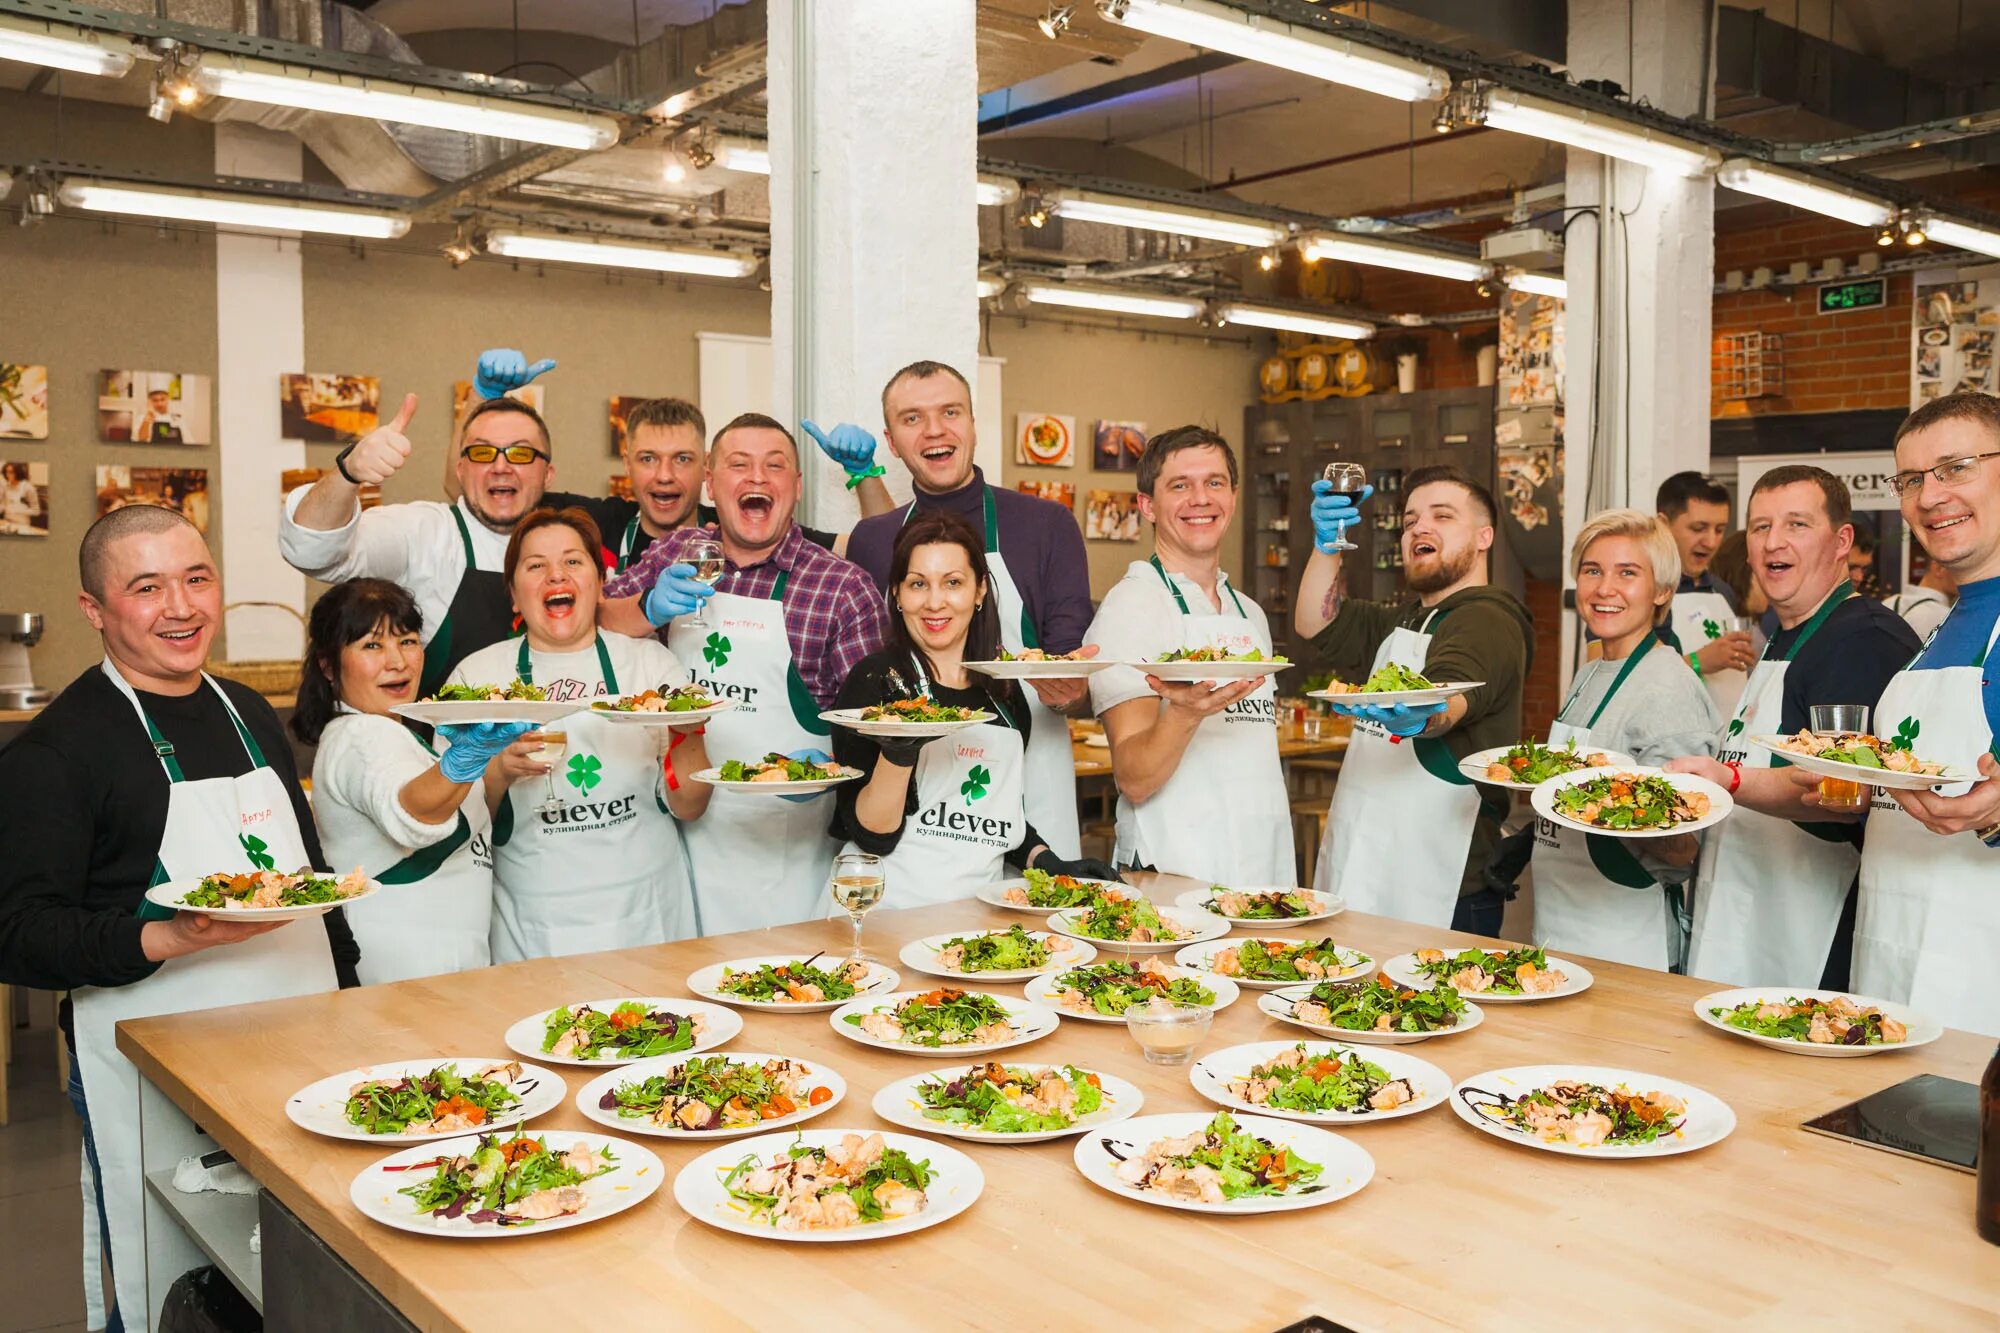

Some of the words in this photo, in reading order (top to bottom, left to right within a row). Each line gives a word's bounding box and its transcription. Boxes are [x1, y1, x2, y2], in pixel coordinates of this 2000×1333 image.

[1836, 472, 1886, 491] ver
[543, 822, 606, 835] кулинарная
[608, 811, 638, 826] студия
[920, 801, 1012, 839] clever
[916, 826, 978, 843] кулинарная
